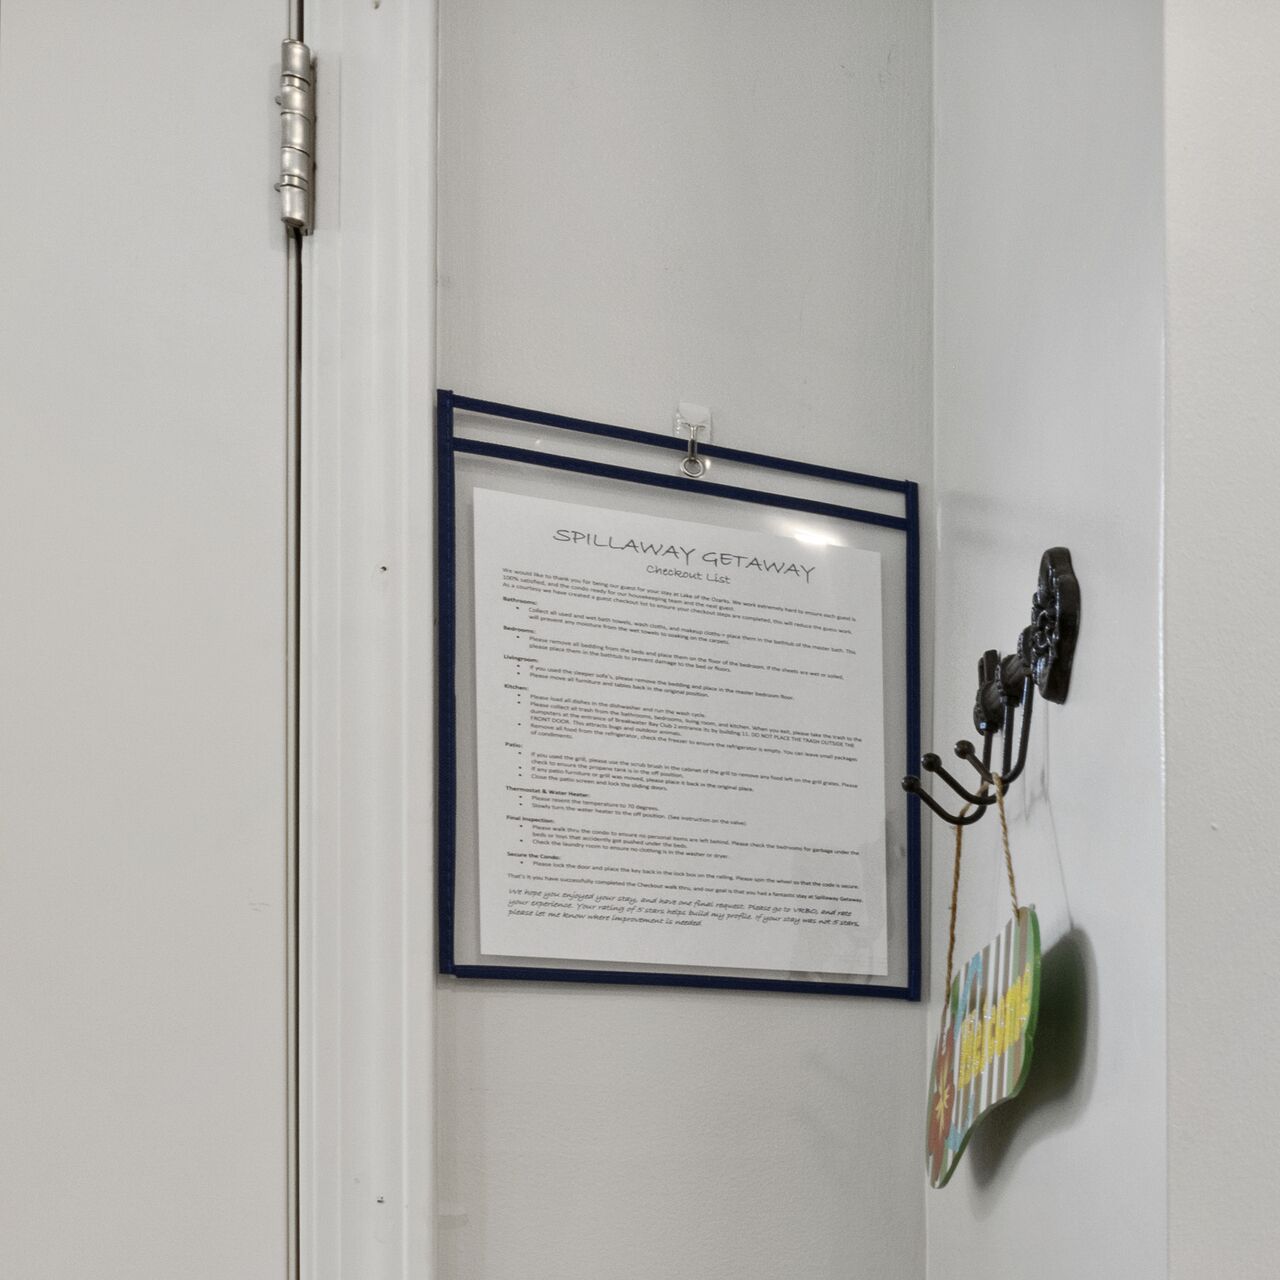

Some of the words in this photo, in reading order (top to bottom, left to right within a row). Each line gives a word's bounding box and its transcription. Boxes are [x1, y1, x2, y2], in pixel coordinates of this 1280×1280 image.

[552, 529, 696, 566] SPILLAWAY
[702, 551, 816, 584] GETAWAY
[645, 564, 703, 582] Checkout
[706, 572, 731, 585] List
